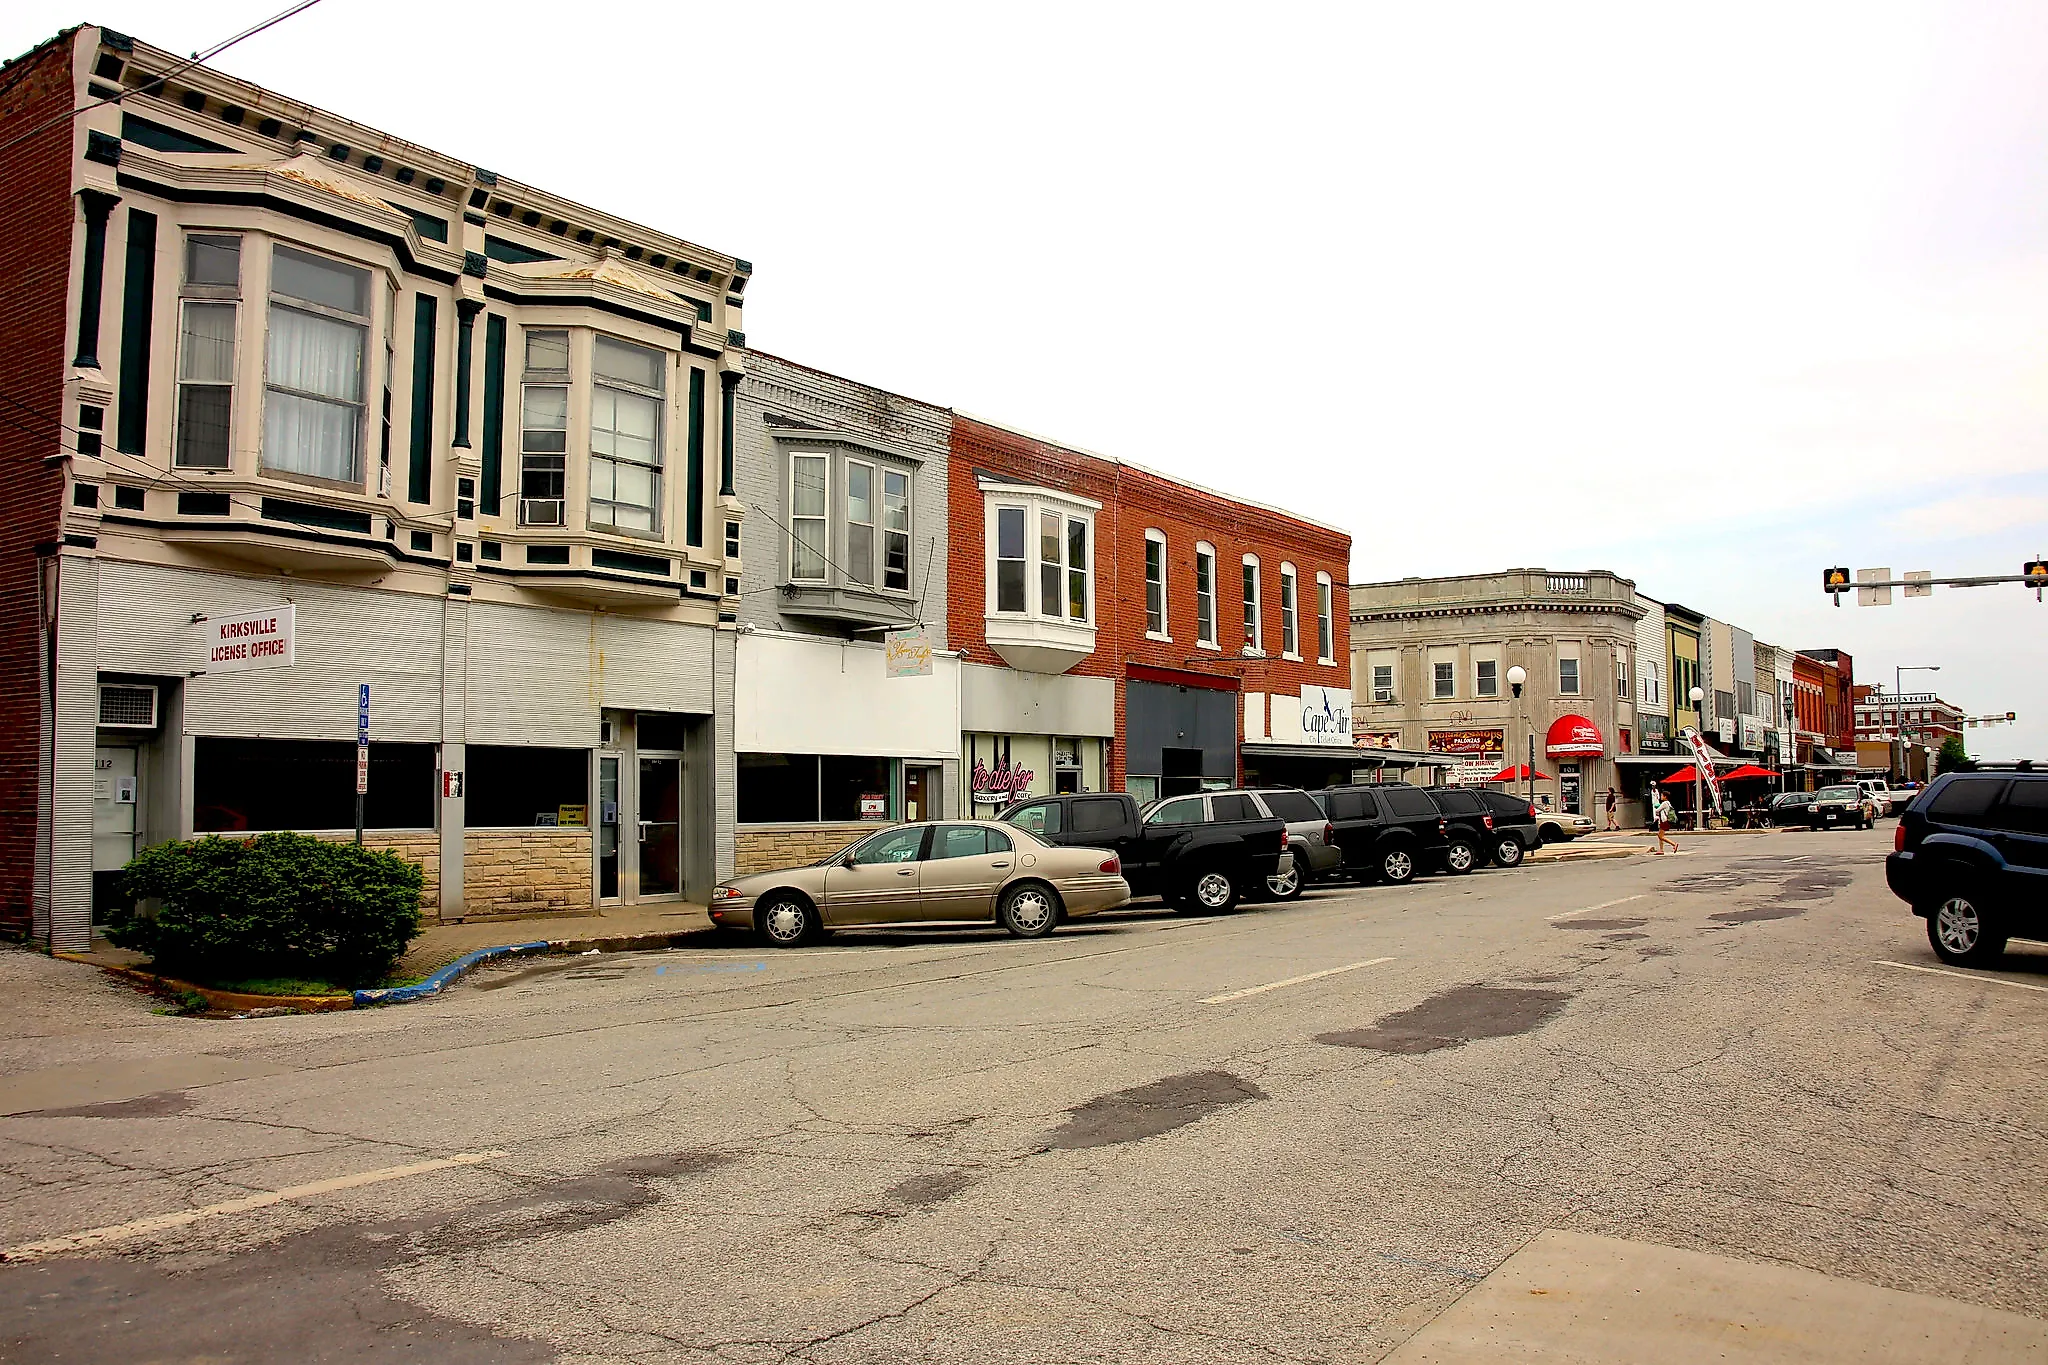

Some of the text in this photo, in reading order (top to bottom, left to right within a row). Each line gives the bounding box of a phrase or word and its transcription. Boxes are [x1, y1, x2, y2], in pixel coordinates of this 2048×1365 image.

[220, 618, 276, 639] KIRKSVILLE
[211, 639, 284, 662] LICENSE OFFICE
[1302, 706, 1349, 744] Cape Air
[973, 754, 1034, 803] to die for
